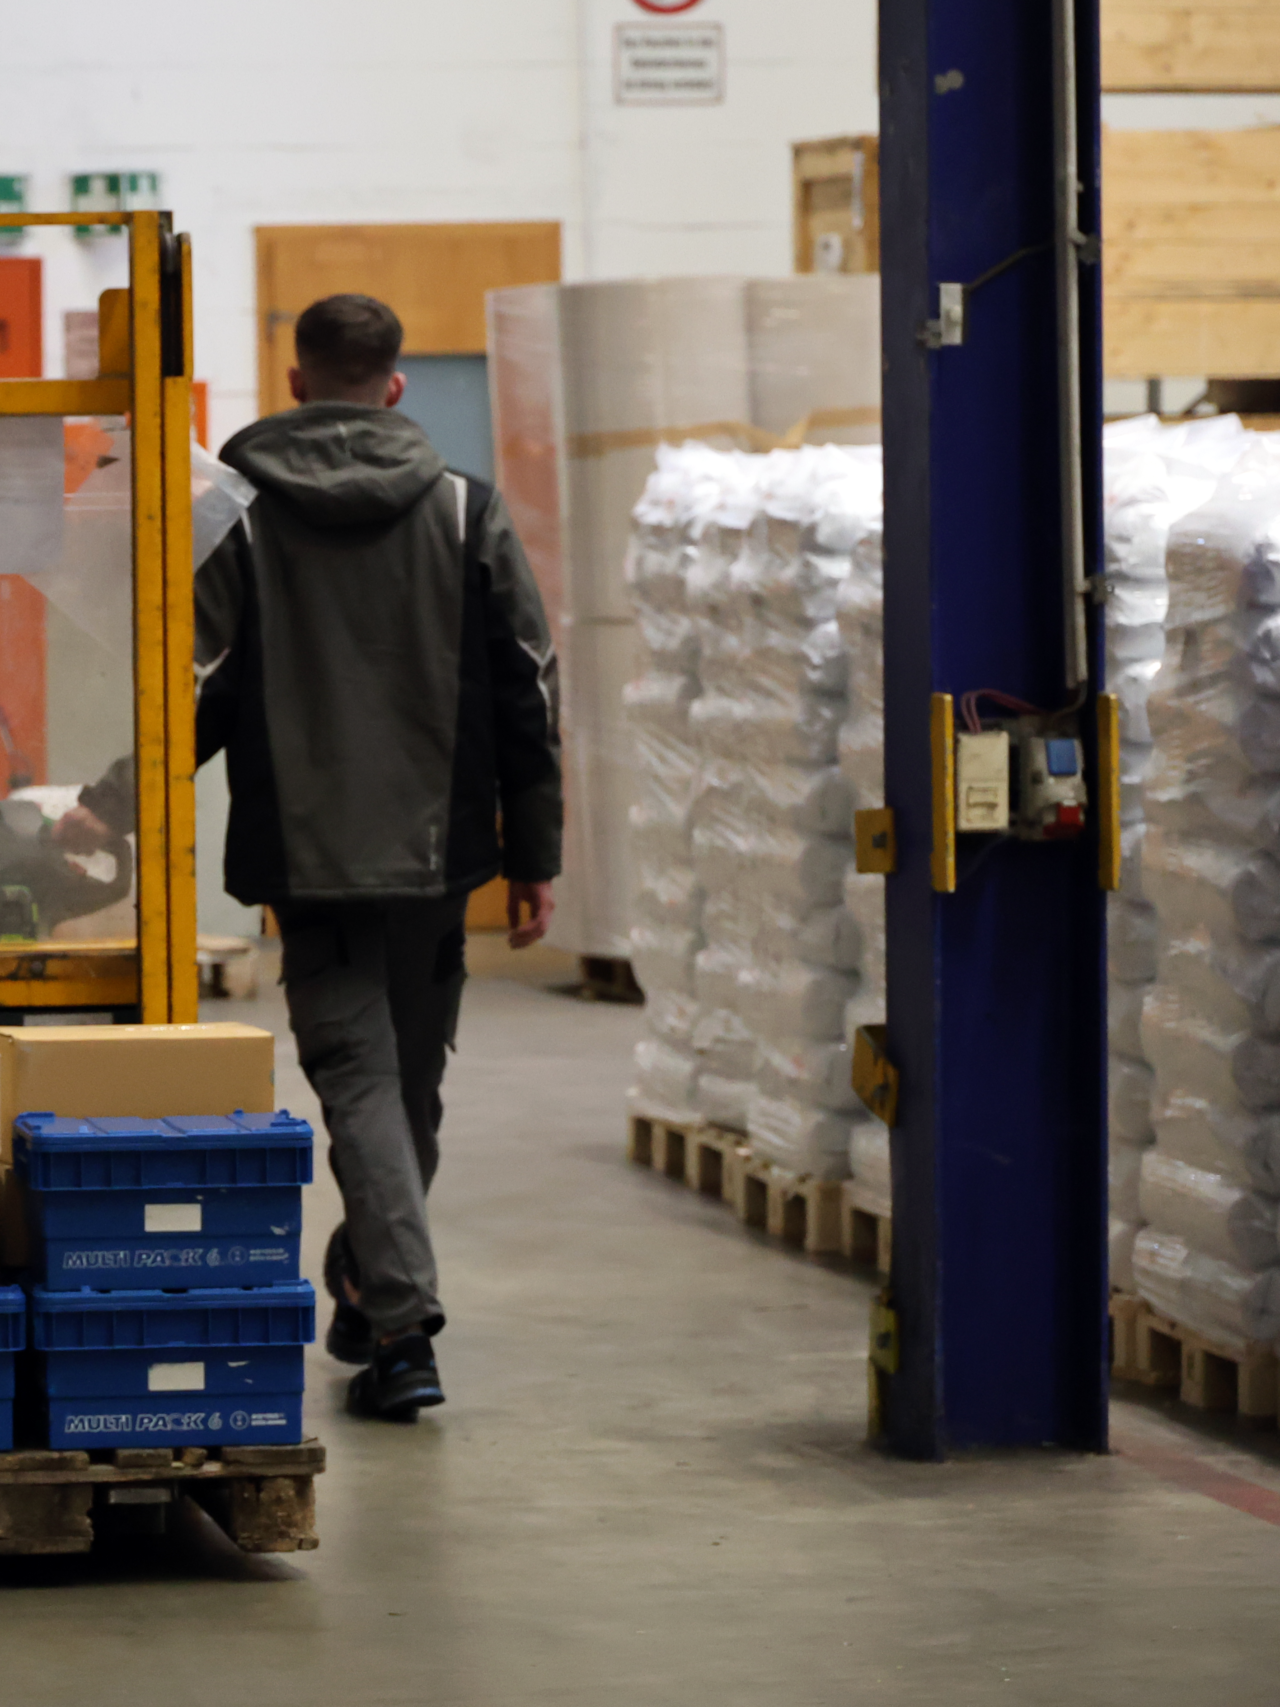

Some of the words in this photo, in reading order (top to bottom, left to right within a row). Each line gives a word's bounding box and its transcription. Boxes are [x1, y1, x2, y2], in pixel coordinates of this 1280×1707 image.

[62, 1250, 131, 1269] MULTI
[133, 1249, 203, 1267] PACK
[65, 1414, 132, 1432] MULTI
[135, 1412, 206, 1431] PACK
